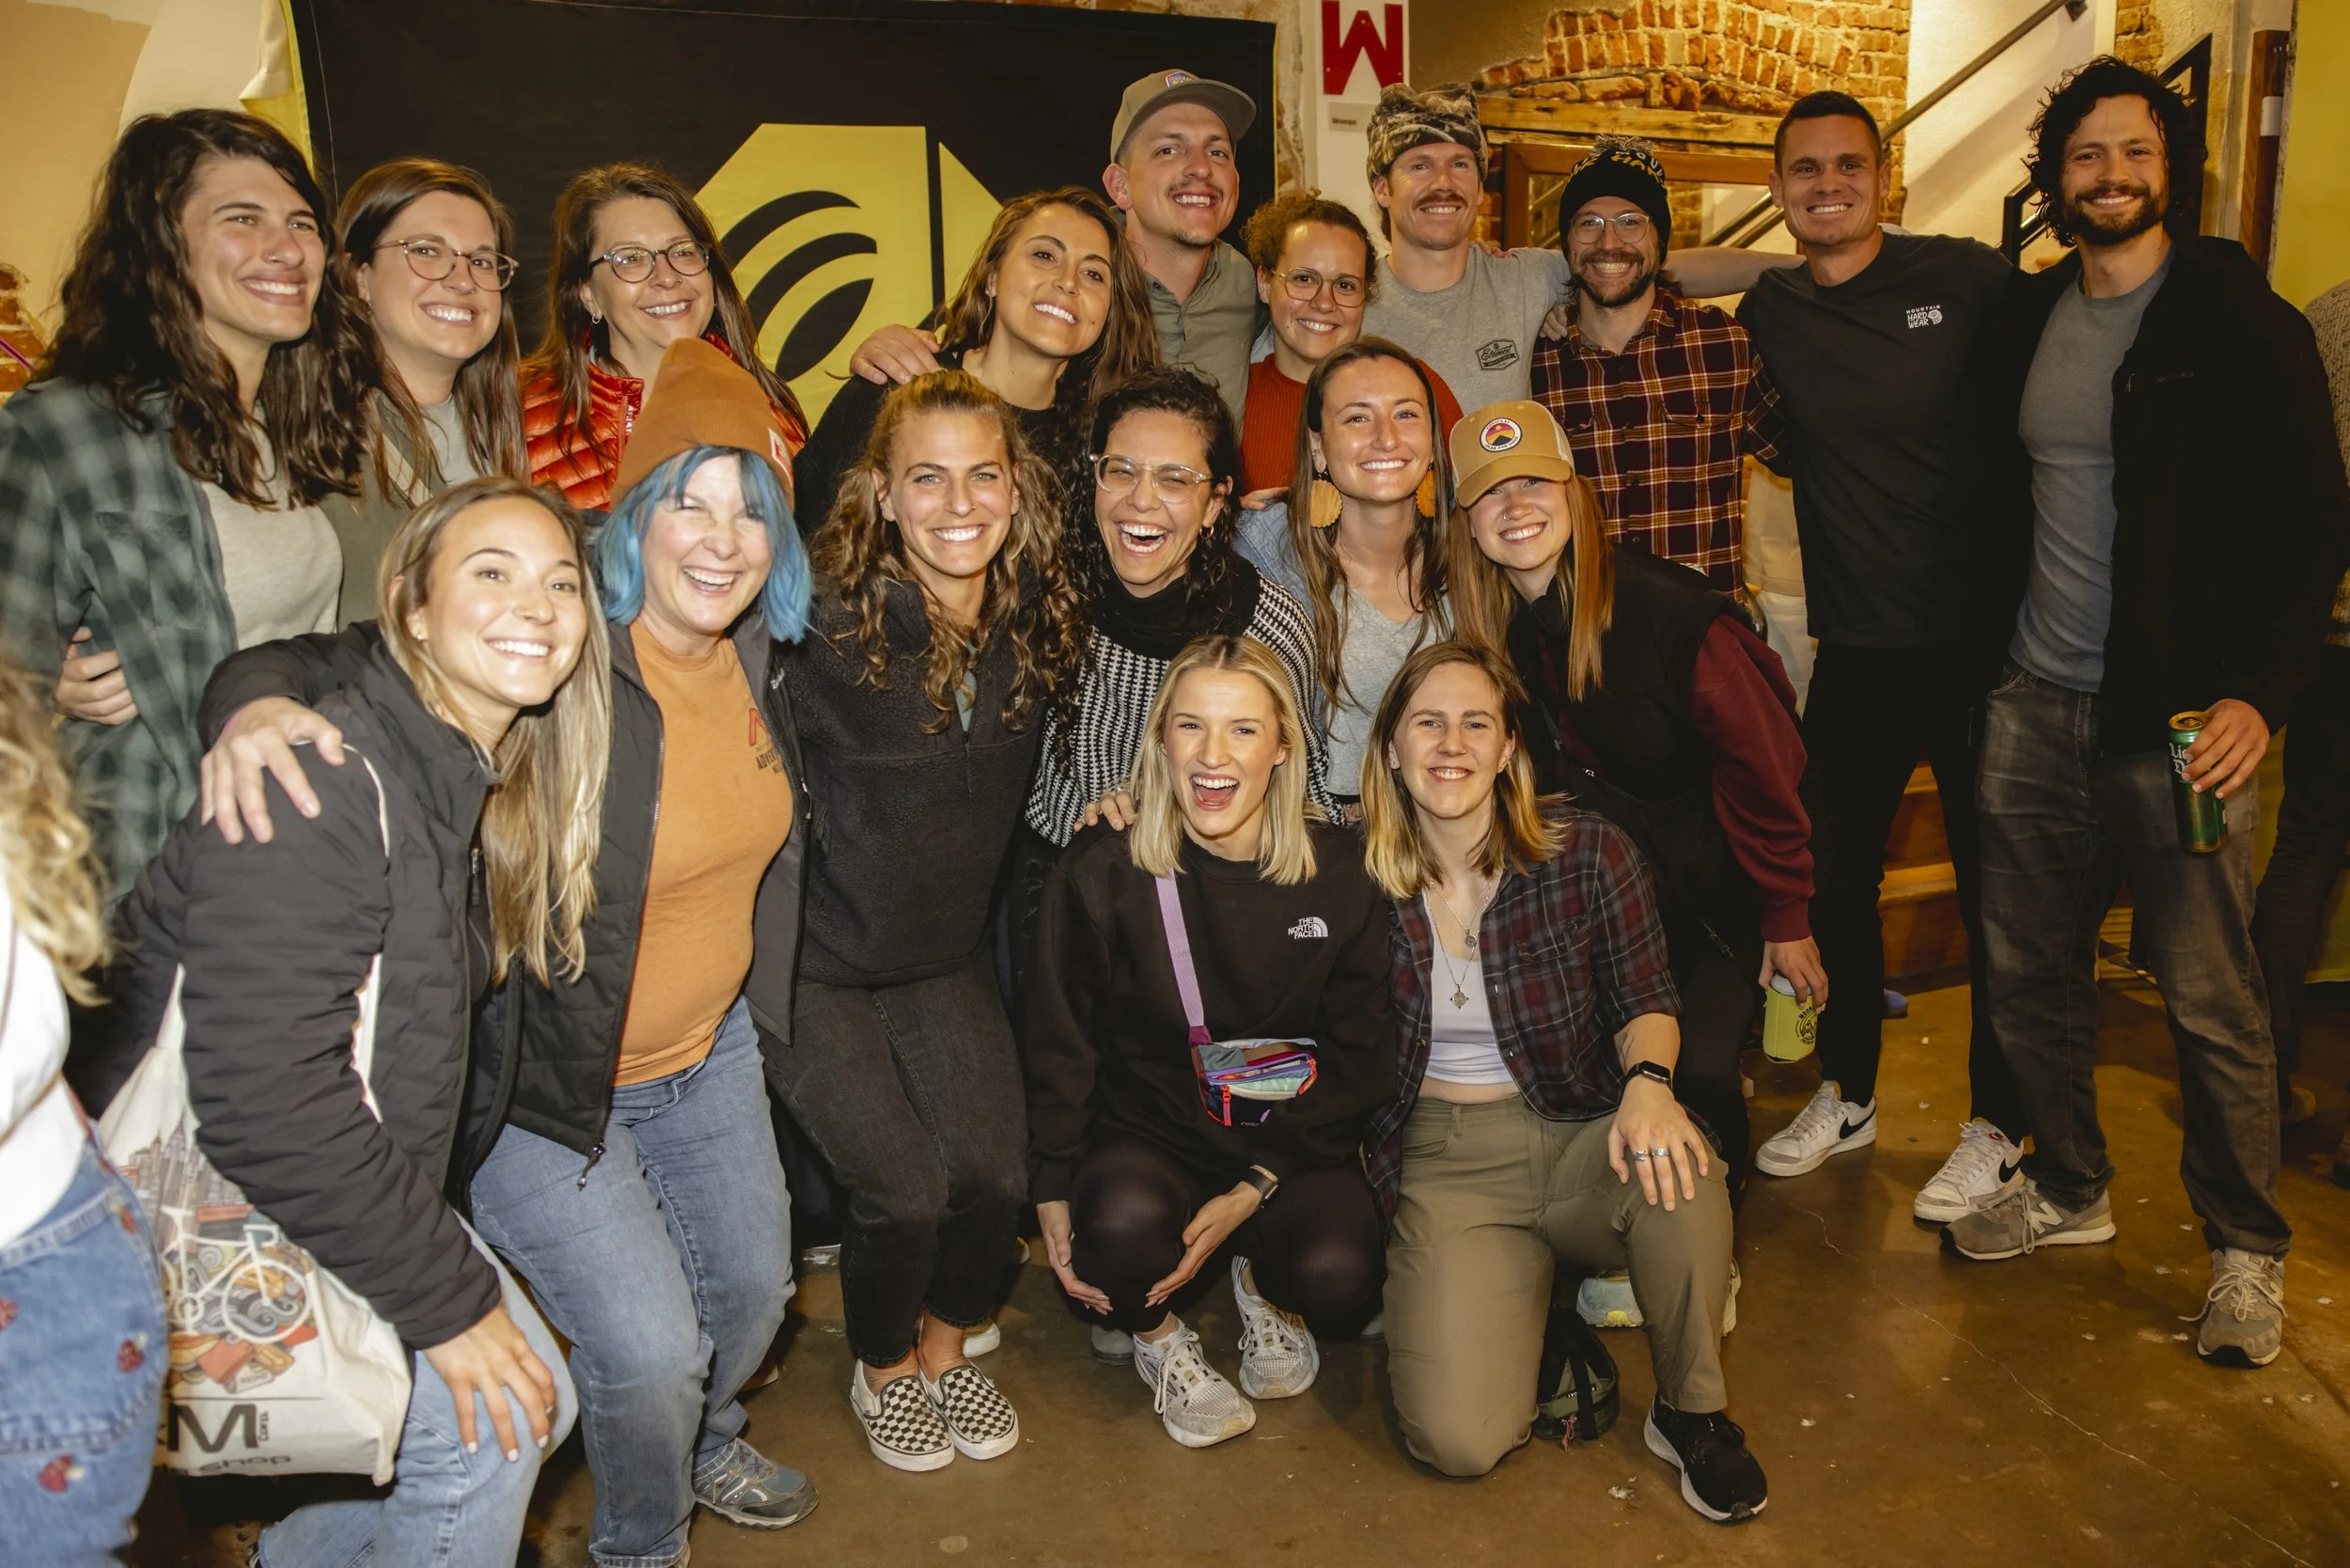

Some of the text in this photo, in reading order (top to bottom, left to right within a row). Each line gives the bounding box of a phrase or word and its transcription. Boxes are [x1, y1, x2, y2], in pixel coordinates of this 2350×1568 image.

[1321, 0, 1404, 96] W
[1905, 305, 1940, 314] MOUNTAIN
[1907, 311, 1927, 321] HARD
[1908, 318, 1929, 329] WEAR
[1298, 917, 1314, 926] THE
[1288, 923, 1314, 935] NORTH
[1294, 930, 1314, 940] FACE
[199, 1454, 292, 1472] shop
